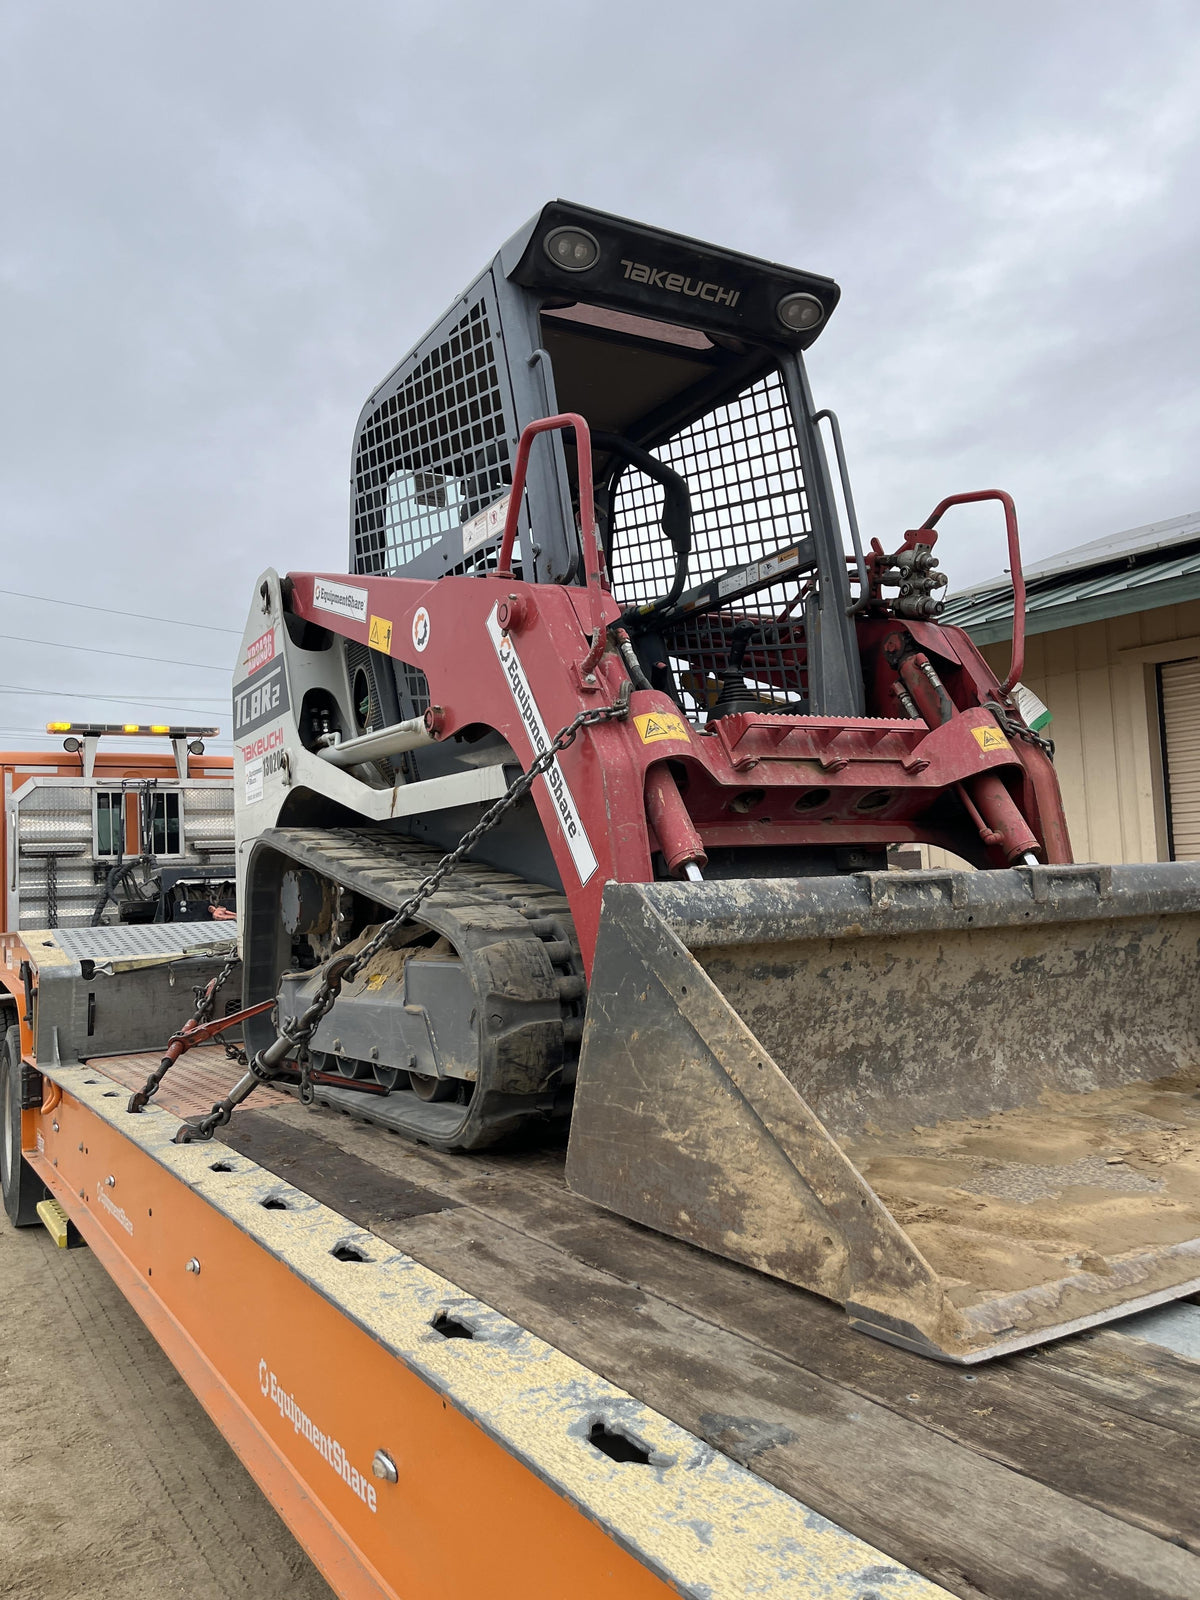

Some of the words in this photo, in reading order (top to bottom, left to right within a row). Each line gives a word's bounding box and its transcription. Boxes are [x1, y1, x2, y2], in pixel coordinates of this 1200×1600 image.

[321, 588, 364, 611] EquipmentShare
[507, 656, 577, 839] EquipmeShare
[270, 1371, 377, 1513] EquipmentShare
